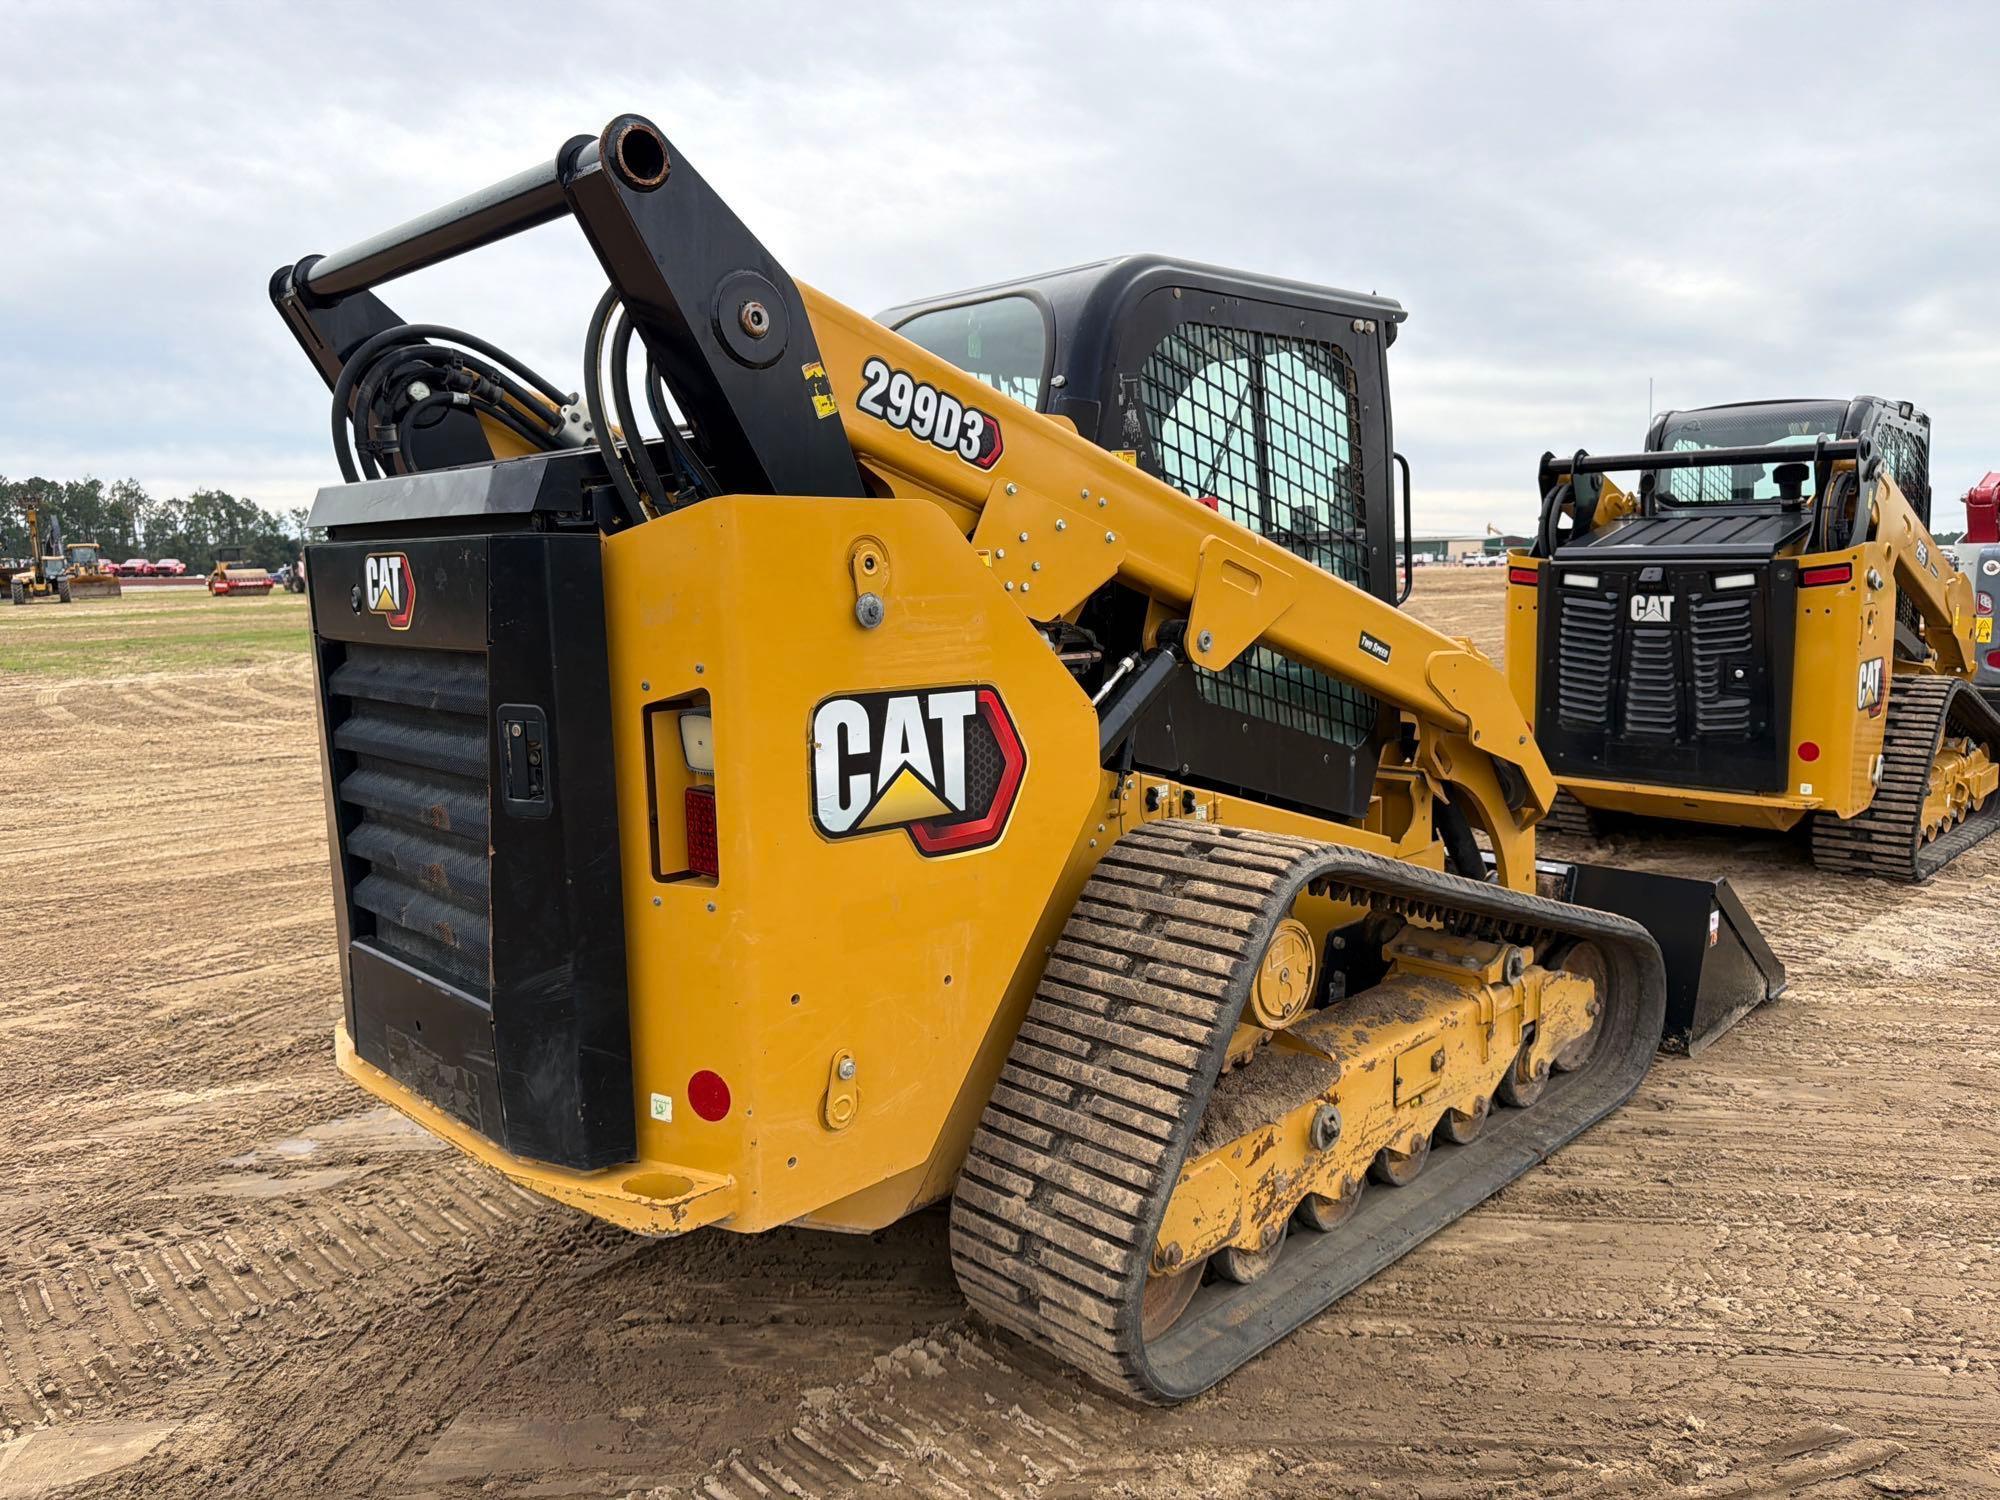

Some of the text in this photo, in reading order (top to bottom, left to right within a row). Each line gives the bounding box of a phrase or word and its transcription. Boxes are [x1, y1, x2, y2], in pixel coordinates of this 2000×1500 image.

[859, 360, 984, 460] 299D3
[366, 556, 401, 610] CAT
[1630, 594, 1675, 622] CAT
[1858, 658, 1882, 709] CAT
[814, 690, 976, 832] CAT
